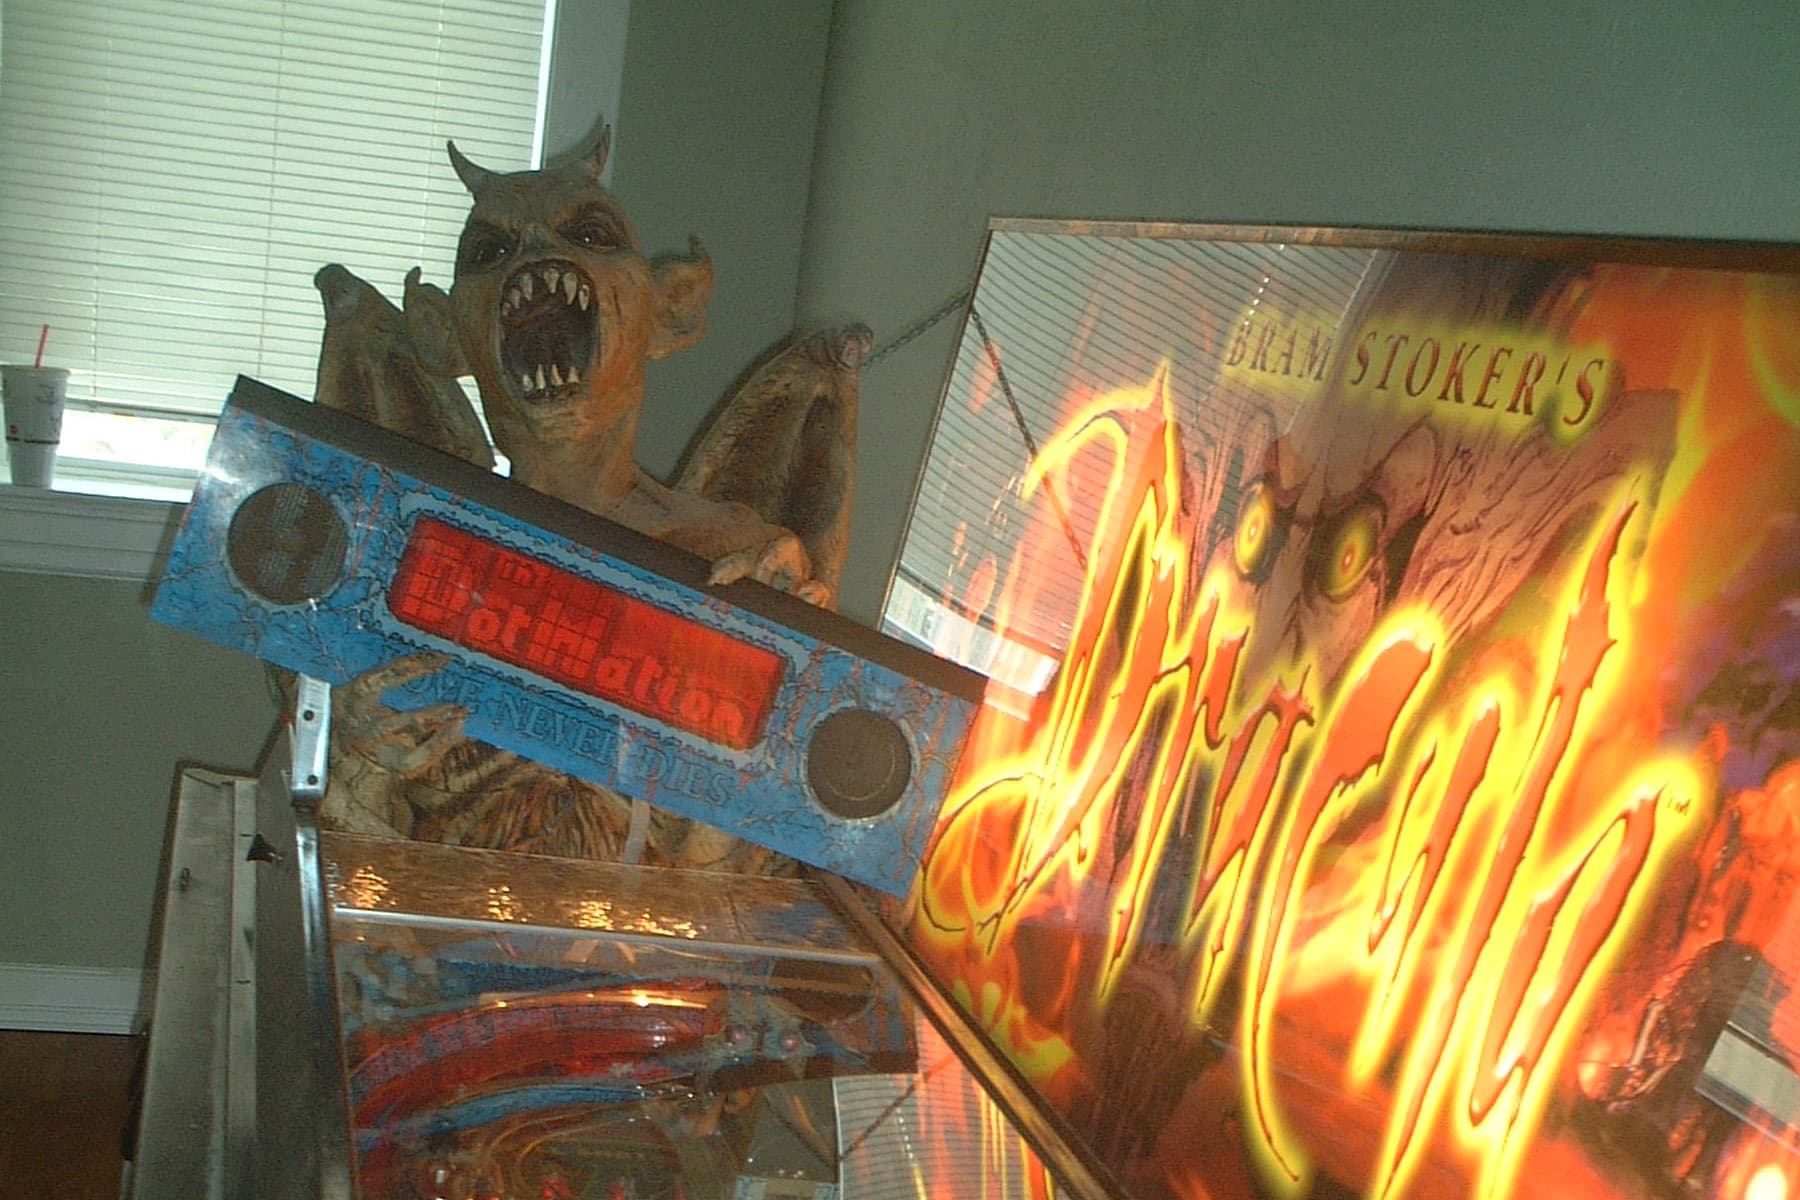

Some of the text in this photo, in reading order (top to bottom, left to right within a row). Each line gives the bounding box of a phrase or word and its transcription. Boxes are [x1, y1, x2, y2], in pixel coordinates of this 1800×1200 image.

[1226, 319, 1604, 426] BRAM STOKER'S
[637, 744, 735, 807] DIES
